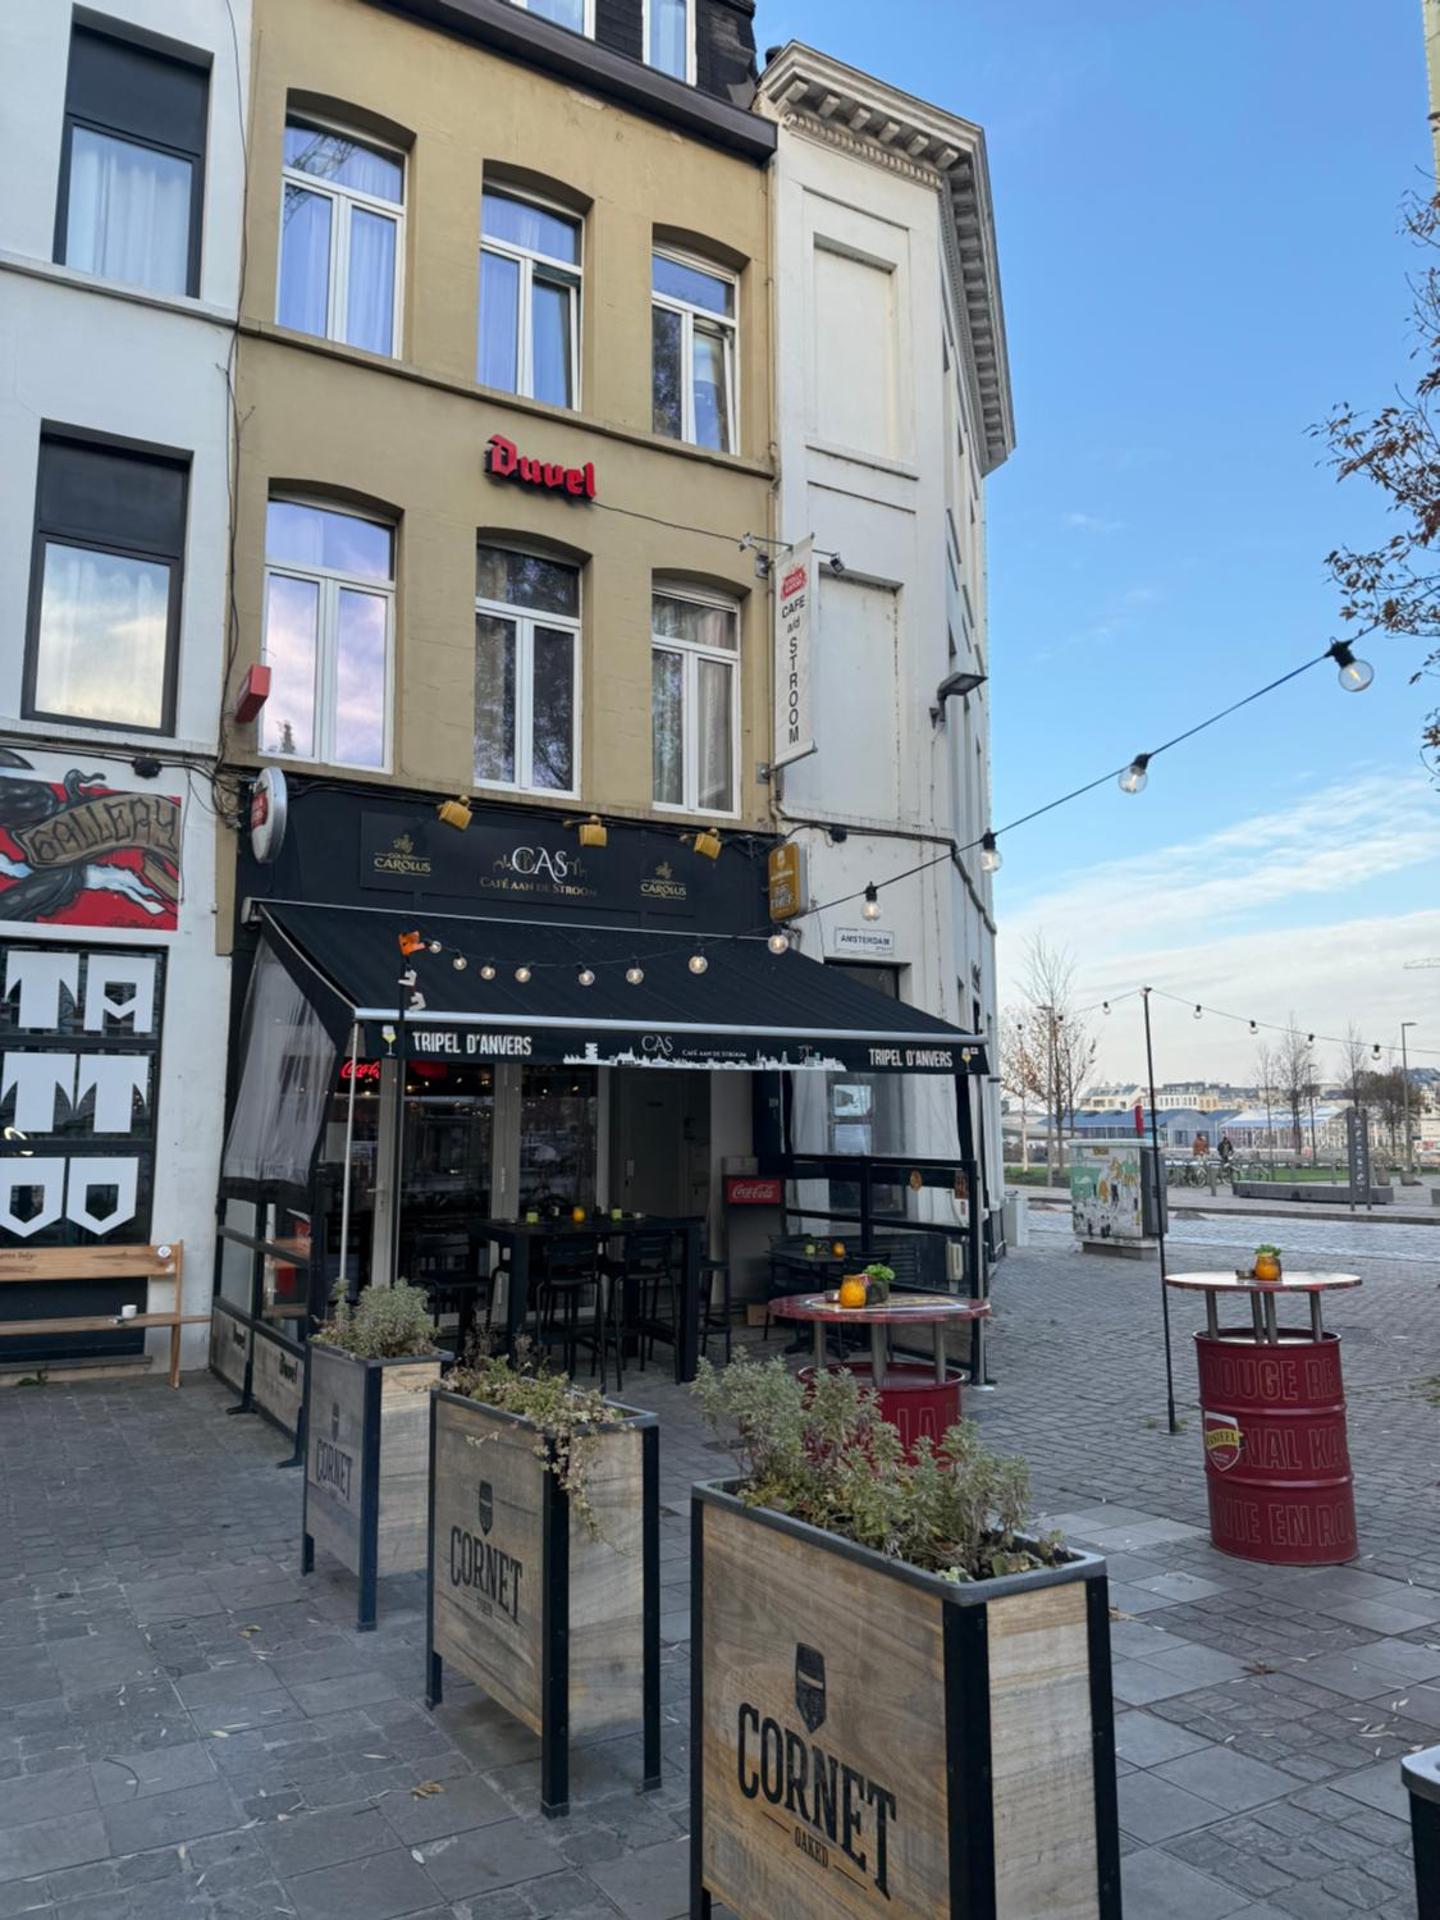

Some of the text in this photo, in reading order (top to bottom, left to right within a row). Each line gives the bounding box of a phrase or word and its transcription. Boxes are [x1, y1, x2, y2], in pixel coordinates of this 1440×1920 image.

[486, 434, 596, 498] Duvel
[789, 636, 799, 745] STROOM
[374, 857, 431, 873] CAROLUS
[512, 846, 567, 884] CAS
[641, 882, 687, 897] CAROLUS
[412, 1031, 532, 1056] TRIPEL D'ANVERS
[868, 1048, 953, 1068] TRIPEL D'ANVERS
[316, 1438, 352, 1501] CORNET
[449, 1525, 524, 1625] CORNET
[738, 1702, 897, 1902] CORNET
[794, 1826, 829, 1869] OAKED
